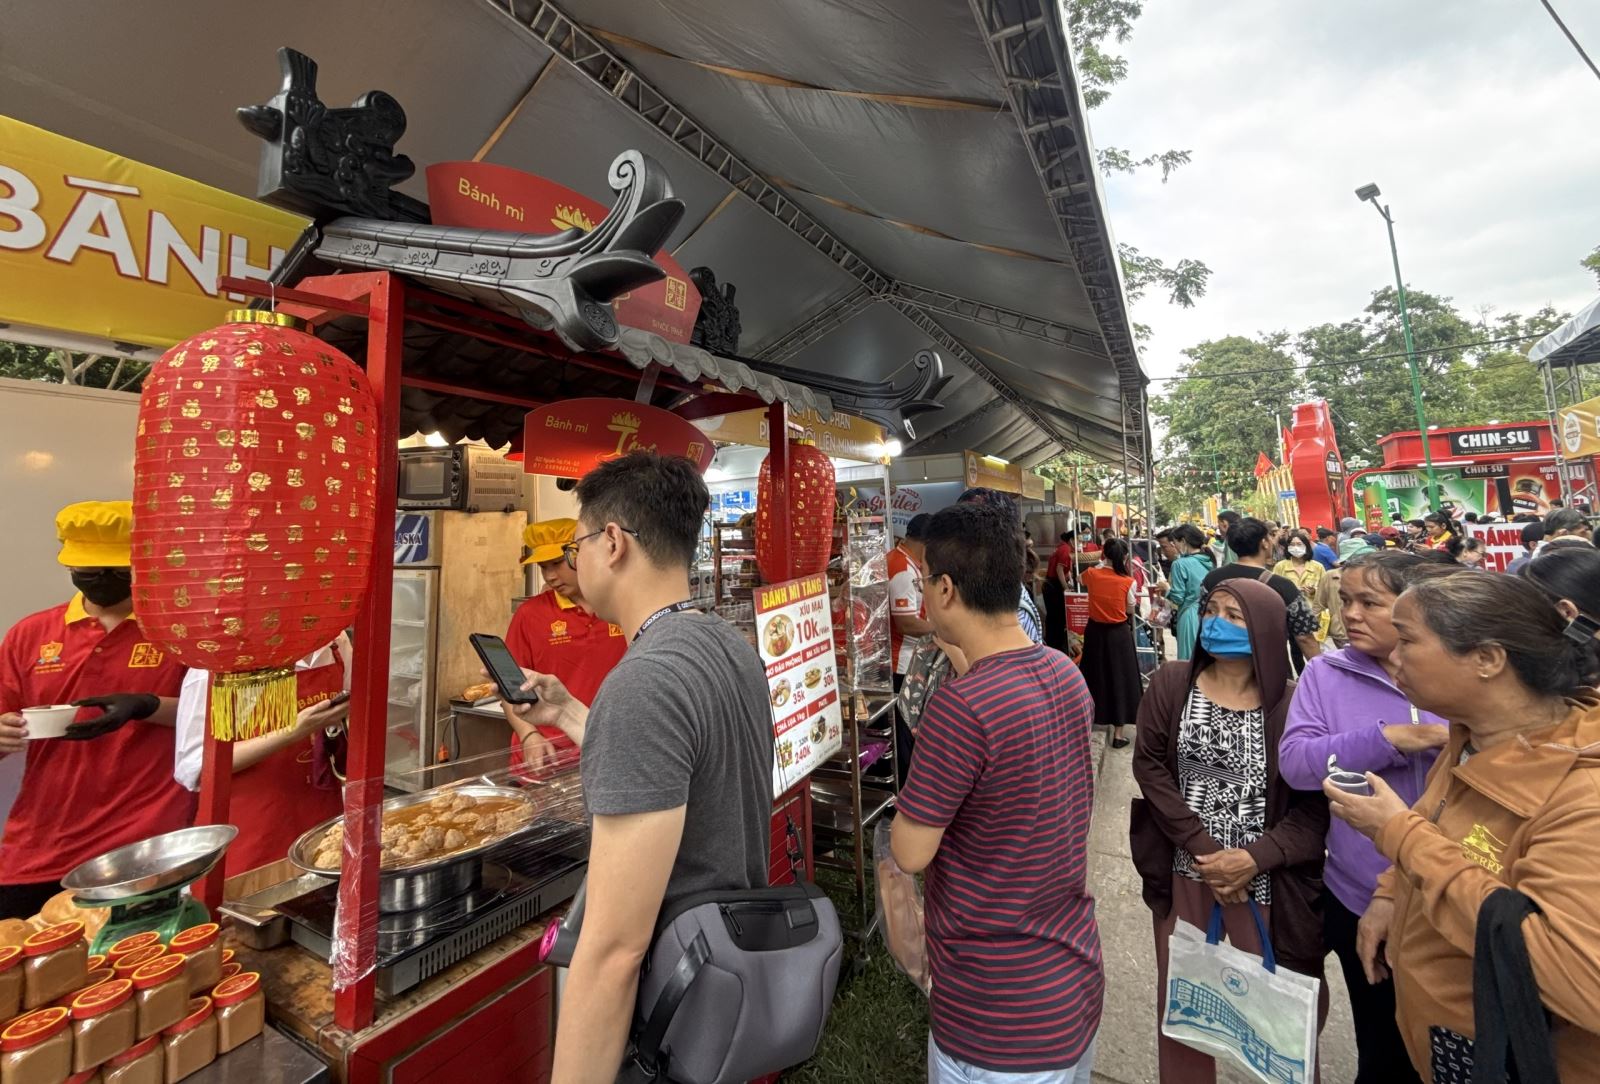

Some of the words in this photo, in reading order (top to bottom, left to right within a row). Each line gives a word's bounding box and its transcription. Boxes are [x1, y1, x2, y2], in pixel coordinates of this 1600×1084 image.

[458, 177, 500, 211] Bánh
[545, 415, 573, 431] Bánh
[1458, 430, 1531, 448] CHIN-SU
[1464, 465, 1504, 474] CHIN-SU
[1382, 474, 1418, 489] XANH
[761, 586, 788, 609] BÁNH
